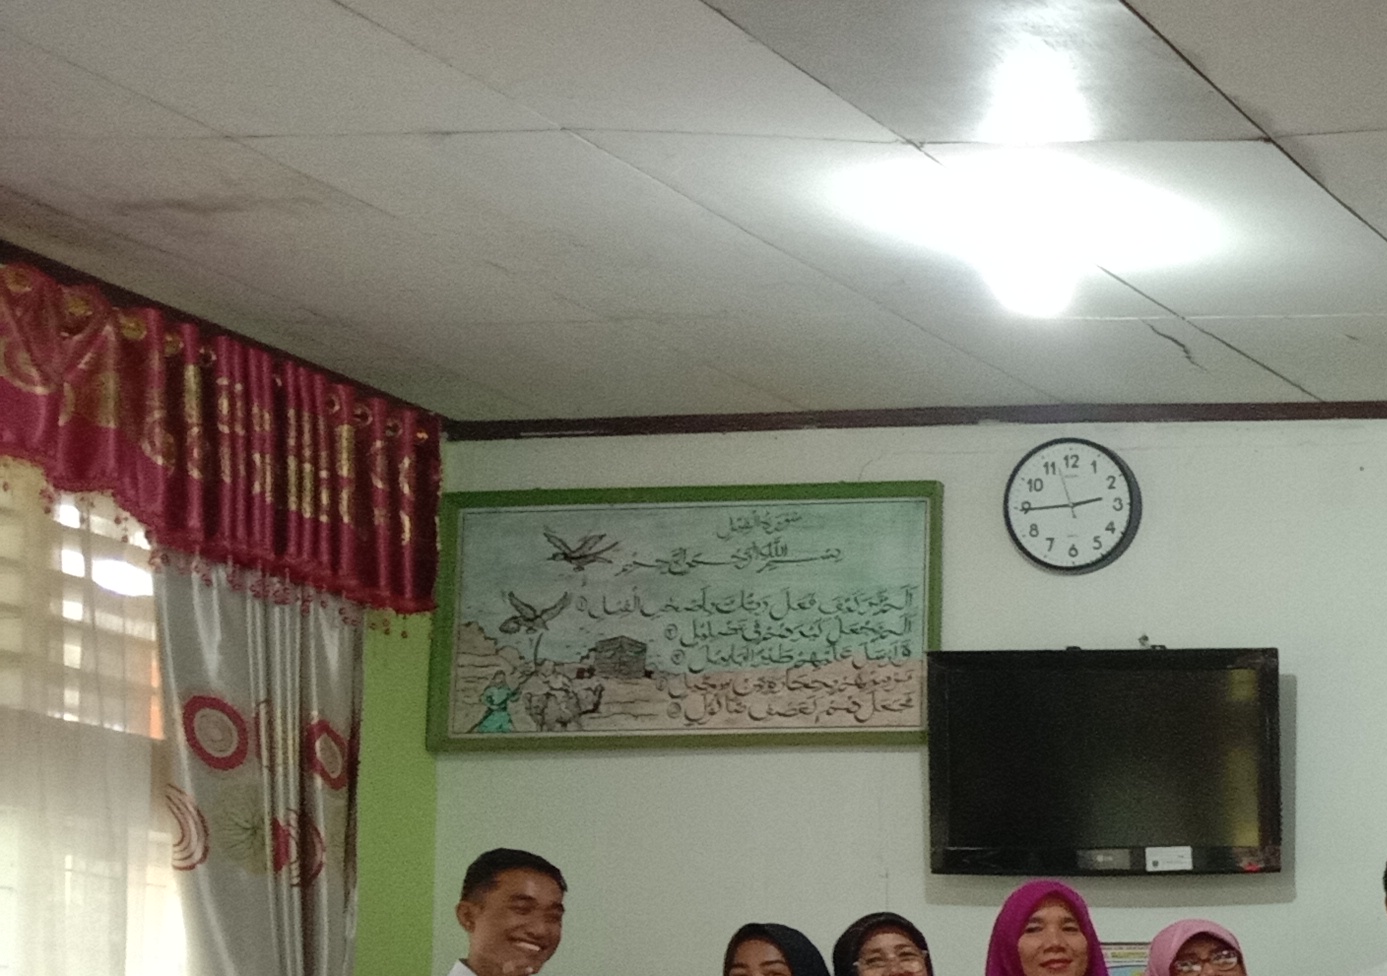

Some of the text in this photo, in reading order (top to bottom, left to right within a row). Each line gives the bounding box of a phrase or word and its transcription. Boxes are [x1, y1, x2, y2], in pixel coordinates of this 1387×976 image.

[1043, 461, 1057, 476] 11
[1063, 454, 1080, 469] 12
[1090, 460, 1098, 474] 1
[1026, 477, 1044, 493] 10
[1105, 475, 1117, 490] 2
[1020, 500, 1032, 515] 9
[1112, 497, 1124, 512] 3
[1028, 523, 1040, 538] 8
[1104, 521, 1116, 535] 4
[1045, 537, 1055, 552] 7
[1092, 535, 1103, 550] 5
[1067, 543, 1079, 558] 6
